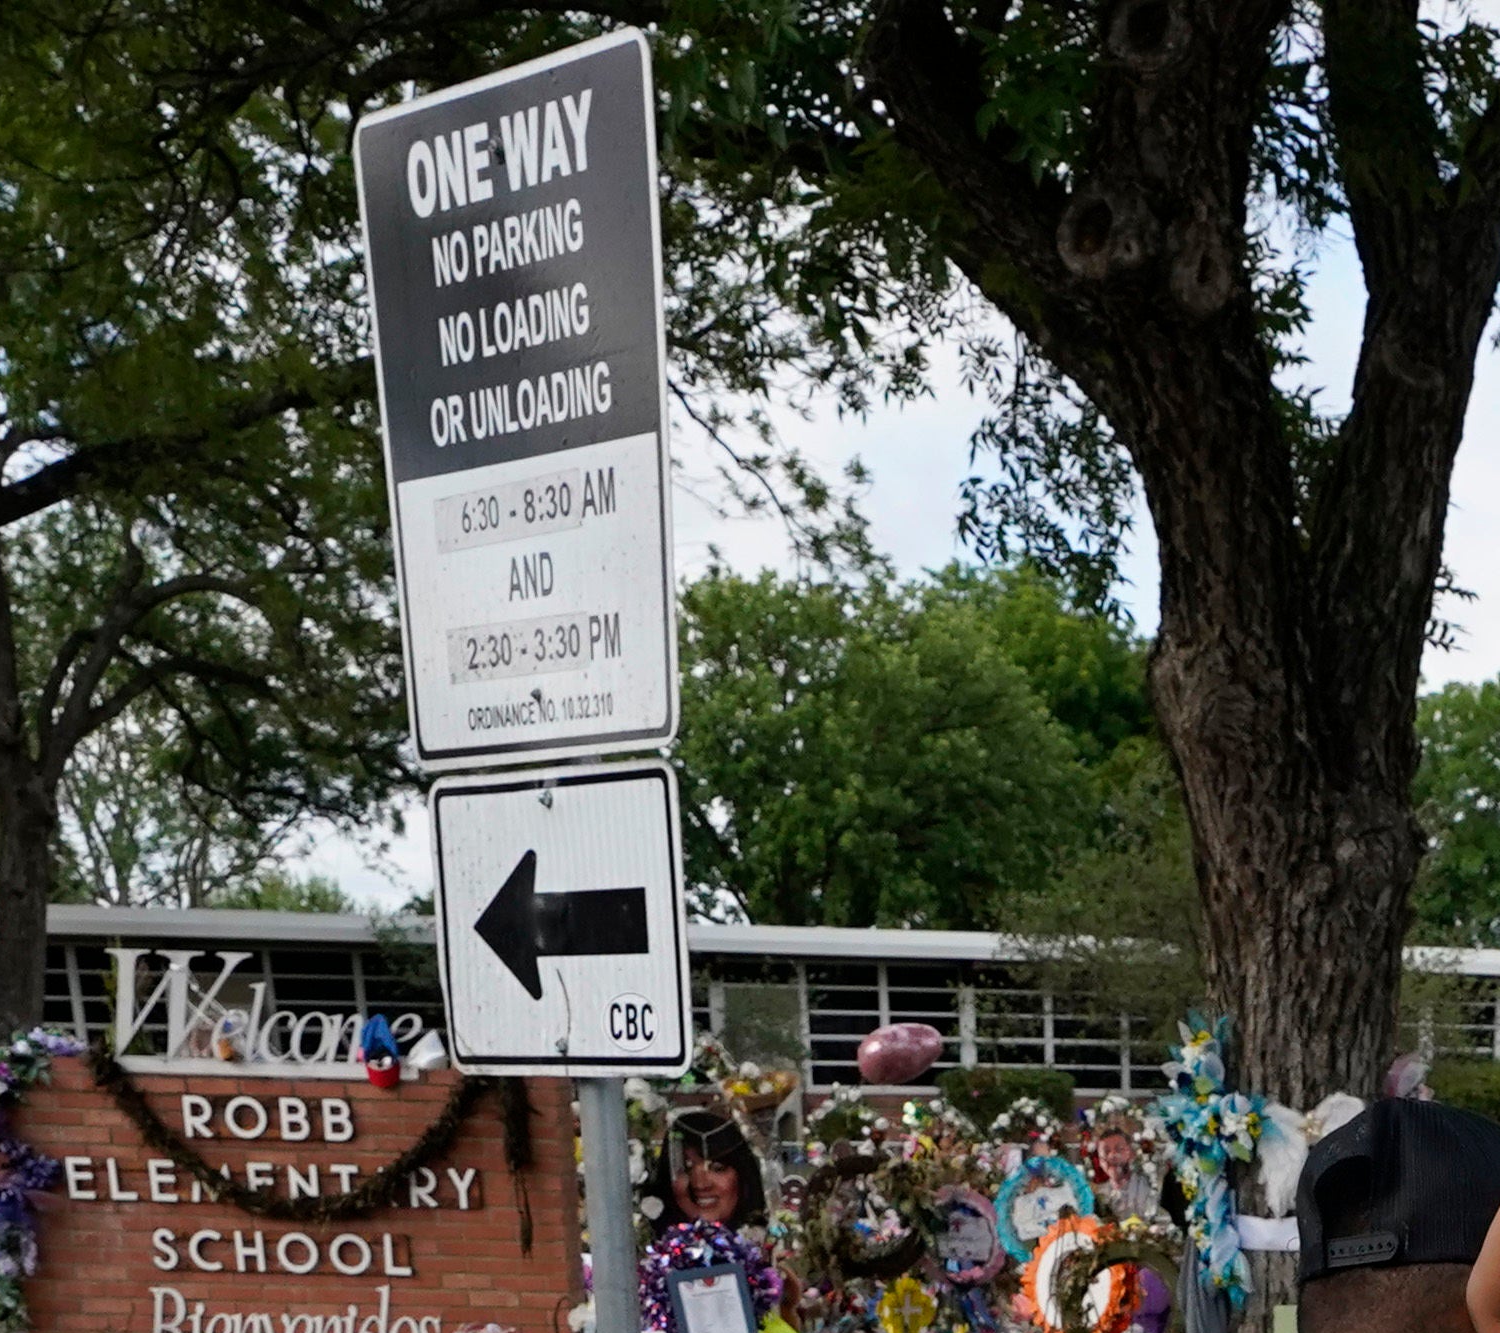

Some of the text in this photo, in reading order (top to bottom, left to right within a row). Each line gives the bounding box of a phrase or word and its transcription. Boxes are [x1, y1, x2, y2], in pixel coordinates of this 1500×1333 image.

[407, 89, 593, 219] ONE WAY
[432, 198, 584, 287] NO PARKING
[438, 282, 590, 367] NO LOADING
[430, 360, 612, 448] OR UNLOADING
[461, 494, 500, 535] 6:30
[524, 481, 572, 525] 8:30
[581, 467, 616, 518] AM
[508, 551, 554, 602] AND
[466, 632, 512, 671] 2:30
[534, 625, 581, 661] 3:30
[588, 612, 622, 661] PM
[467, 700, 536, 732] ORDINANCE
[609, 1003, 655, 1042] CBC
[181, 1094, 354, 1143] ROBB
[64, 1156, 476, 1210] ELEENTRY
[152, 1227, 413, 1277] SCHOOL
